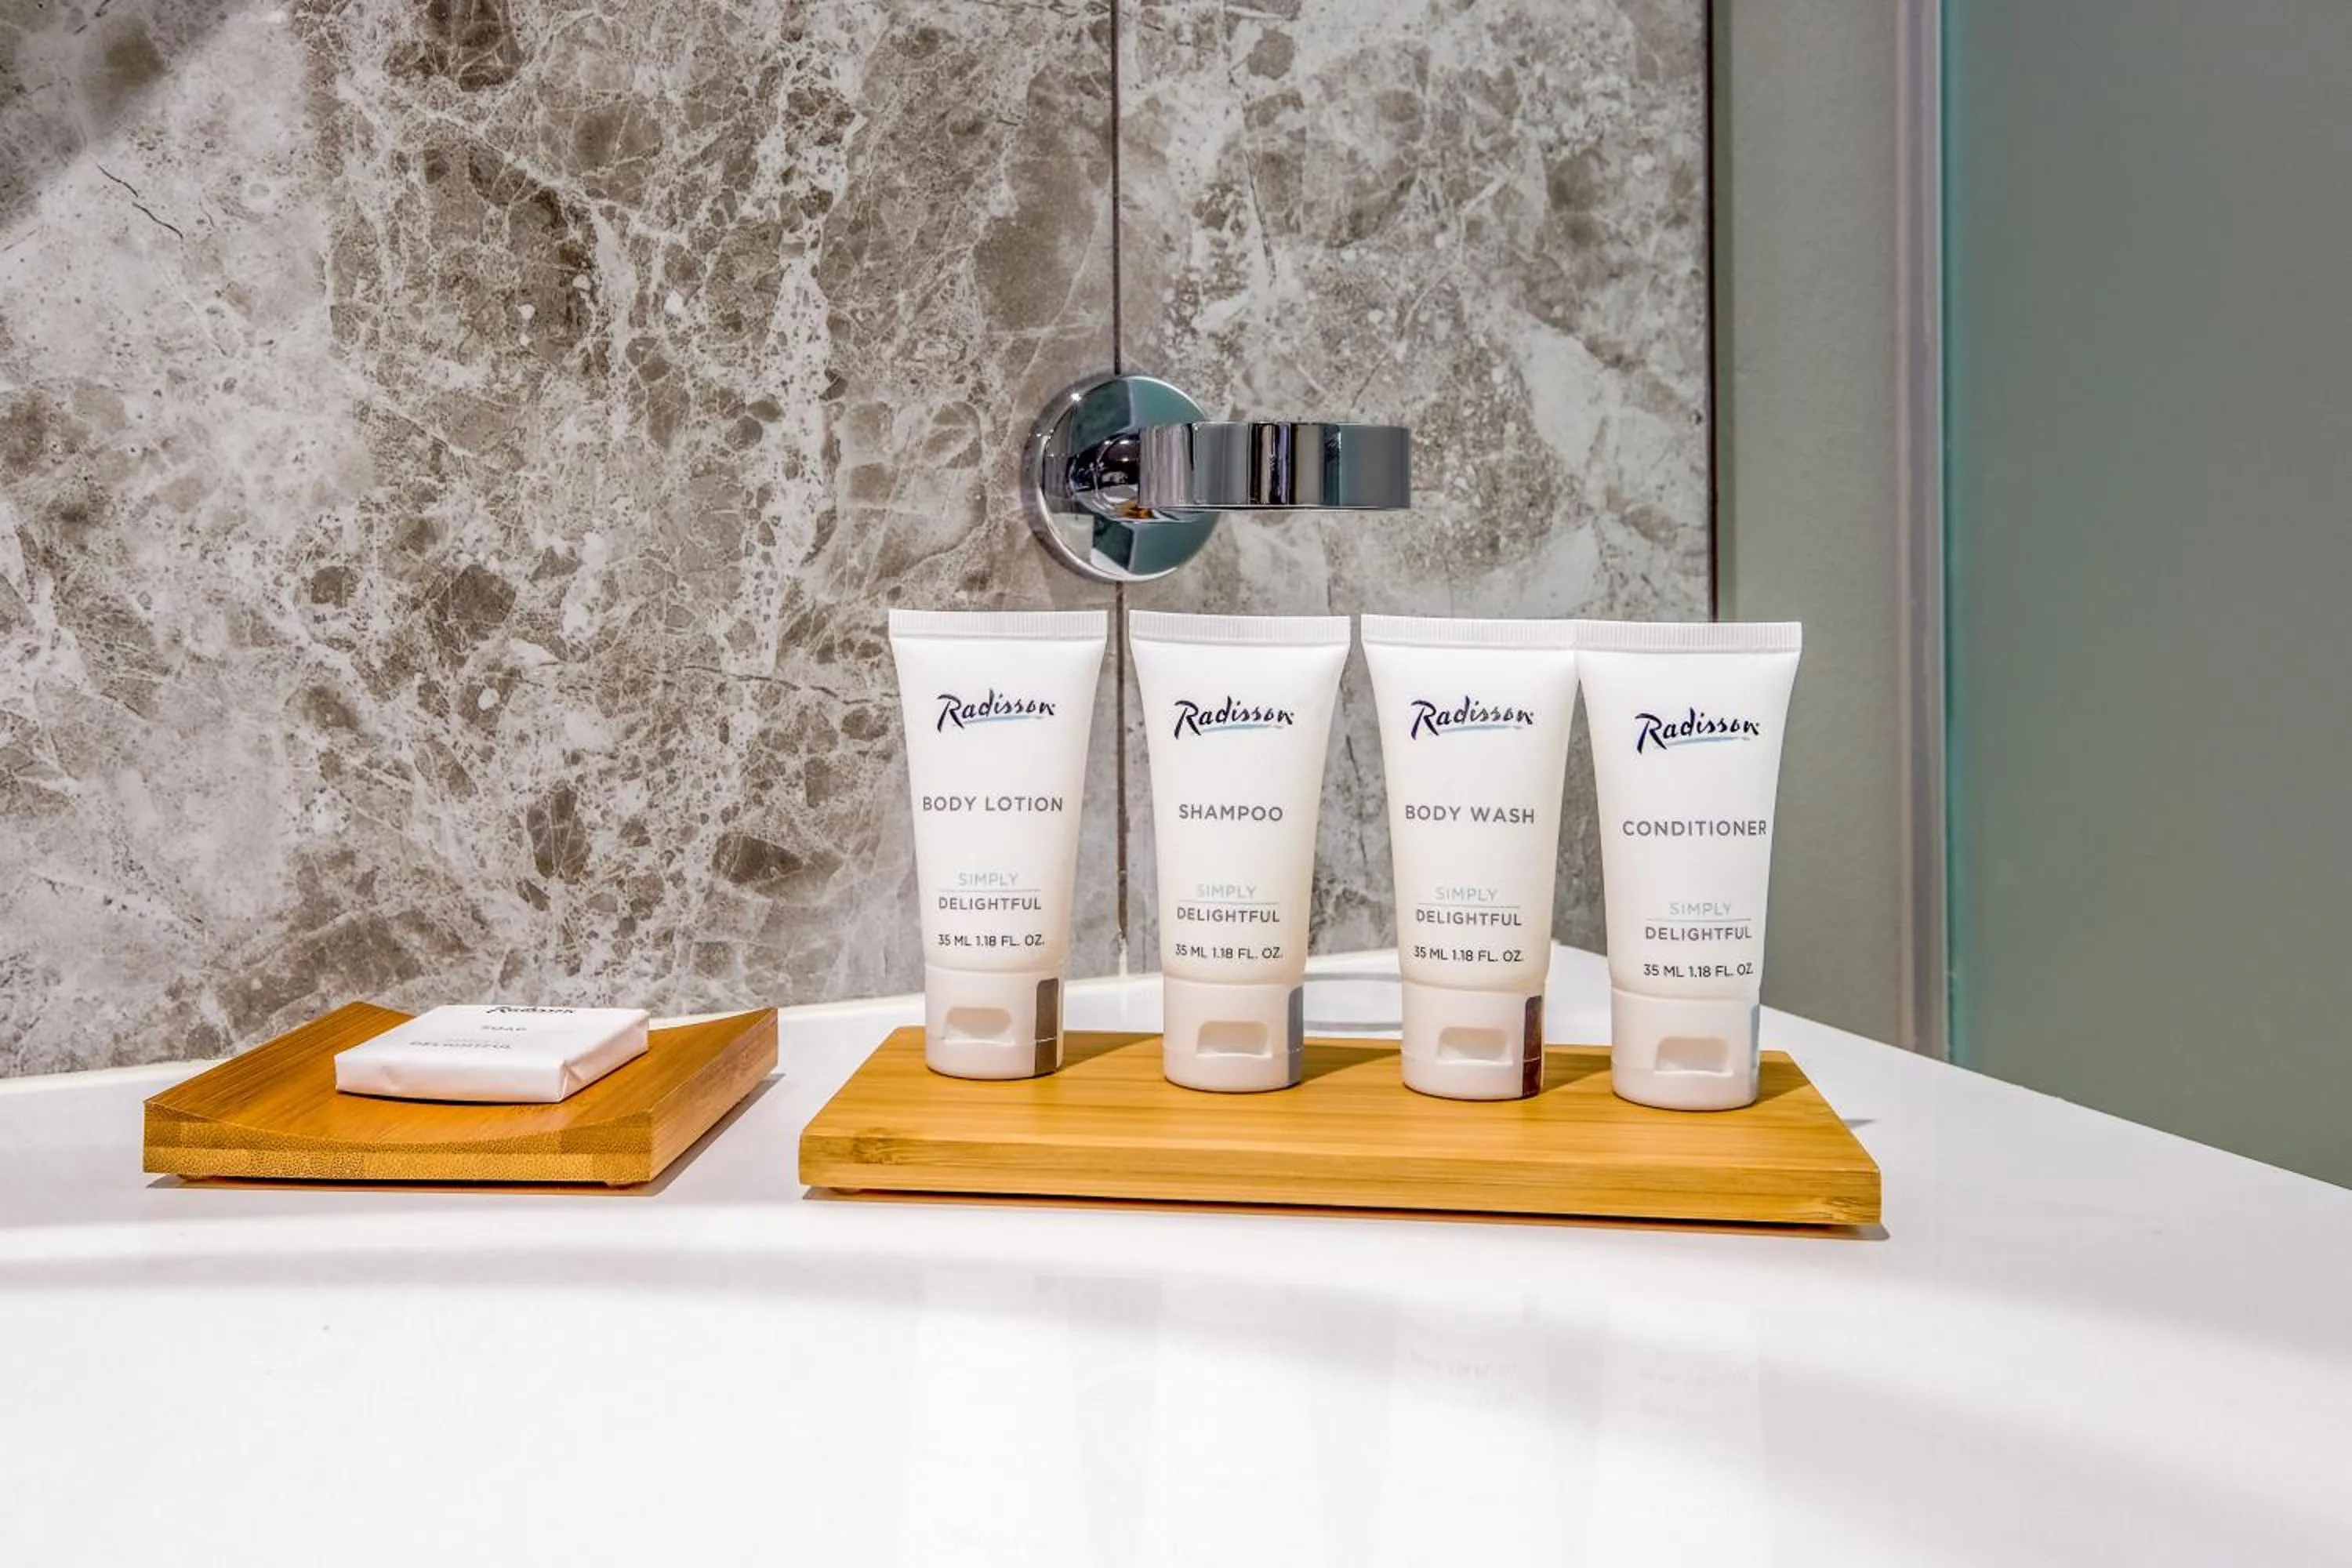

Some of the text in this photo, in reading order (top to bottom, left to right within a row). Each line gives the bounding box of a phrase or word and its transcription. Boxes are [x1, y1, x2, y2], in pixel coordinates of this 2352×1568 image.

[937, 688, 1056, 733] Radisson
[1174, 694, 1294, 739] Radisson
[1410, 695, 1534, 741] Radisson
[1635, 706, 1759, 754] Radisson
[923, 796, 1064, 812] BODY LOTION
[1178, 804, 1283, 822] SHAMPOO
[1405, 804, 1534, 825] BODY WASH
[1621, 819, 1768, 838] CONDITIONER
[958, 872, 1019, 887] SIMPLY
[1196, 883, 1258, 899] SIMPLY
[1435, 886, 1500, 903] SIMPLY
[938, 896, 1042, 911] DELIGHTFUL
[1669, 902, 1732, 916] SIMPLY
[1177, 906, 1280, 924] DELIGHTFUL
[1416, 908, 1523, 927] DELIGHTFUL
[938, 934, 1047, 947] 35 ML 1.18 FL. OZ.
[1645, 924, 1752, 942] DELIGHTFUL
[1175, 943, 1188, 956] 35
[1190, 946, 1207, 959] ML
[1212, 946, 1233, 960] 1.18
[1238, 947, 1258, 960] FL.
[1414, 945, 1427, 959] 35
[1429, 948, 1449, 960] ML
[1452, 949, 1474, 962] 1.18
[1478, 949, 1498, 963] FL.
[1643, 963, 1660, 977] 35
[1663, 965, 1685, 978] ML
[1689, 965, 1711, 978] 1.18
[1715, 965, 1733, 978] FL.
